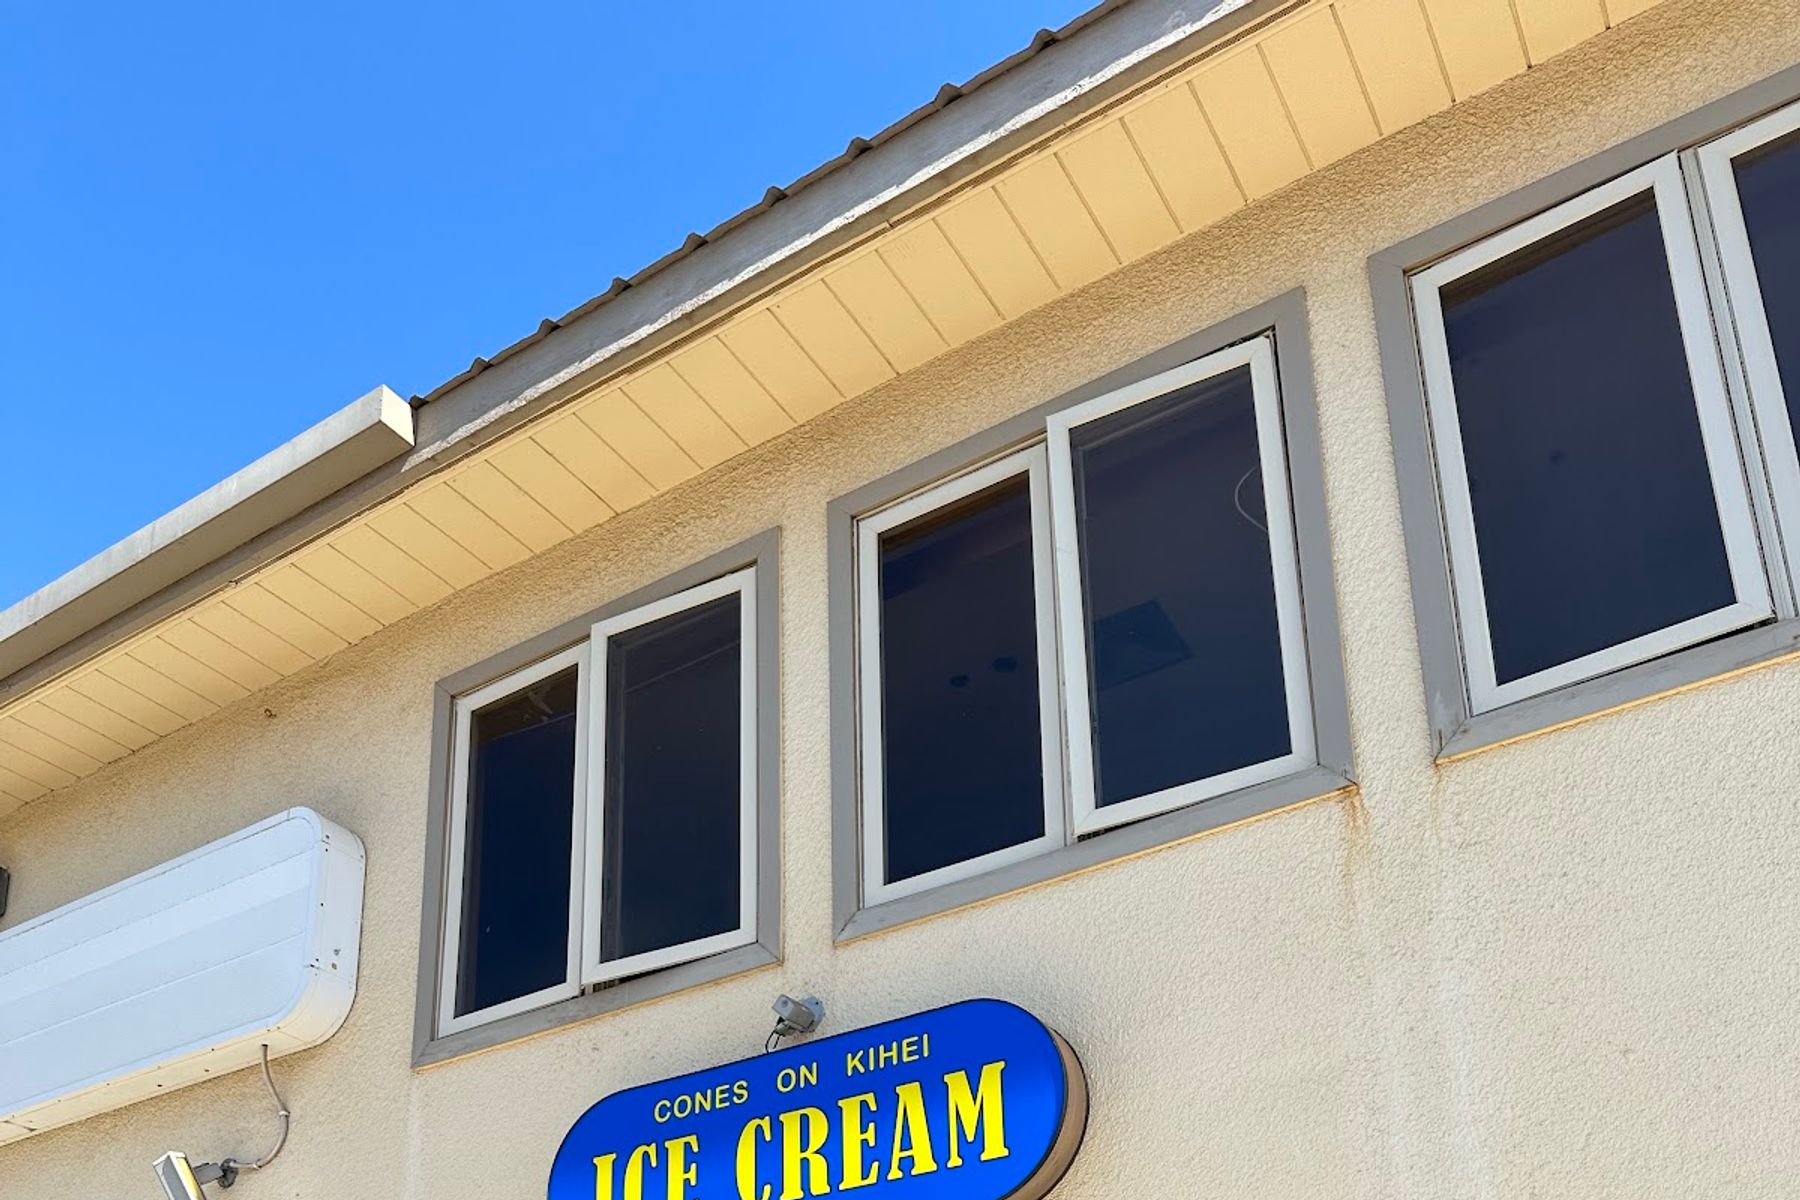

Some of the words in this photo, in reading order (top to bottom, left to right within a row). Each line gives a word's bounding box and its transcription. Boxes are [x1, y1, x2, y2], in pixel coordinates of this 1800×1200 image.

[654, 1080, 749, 1124] CONES
[776, 1062, 819, 1094] ON
[846, 1033, 931, 1076] KIHEI
